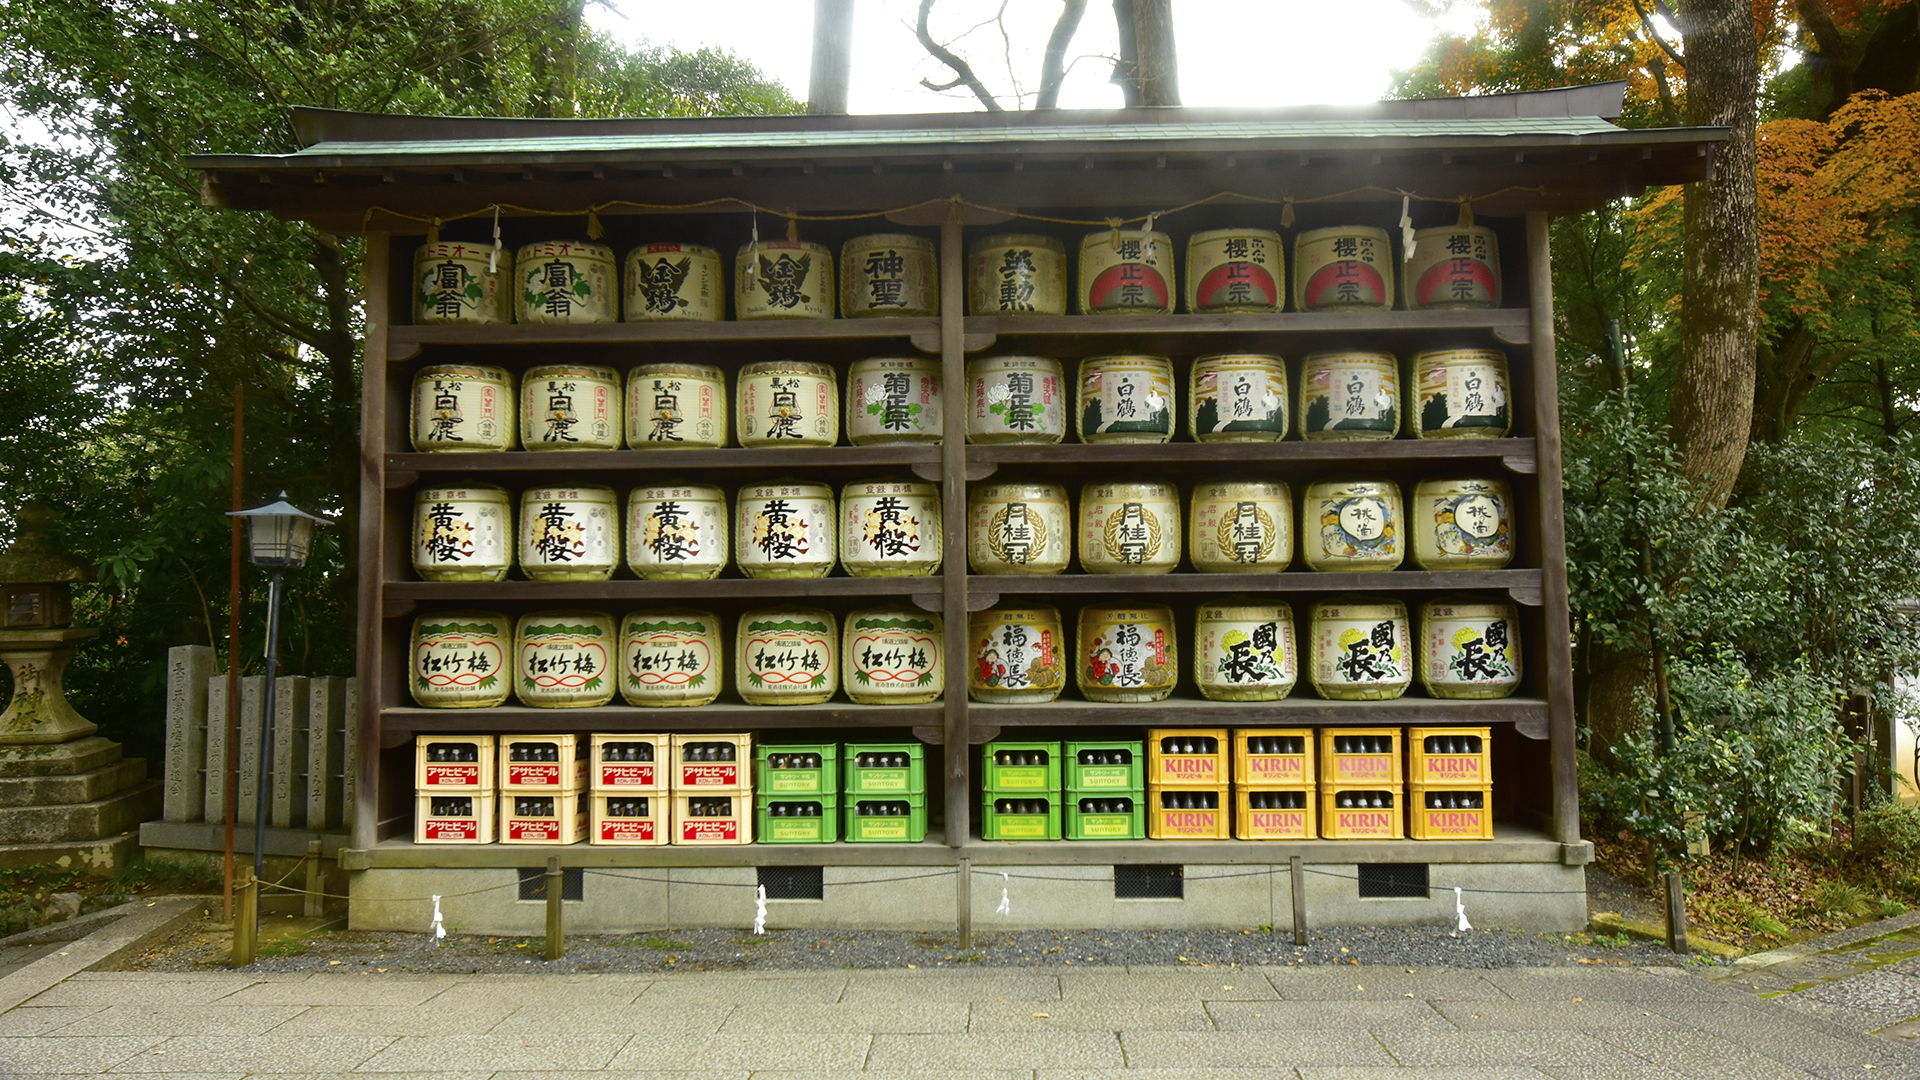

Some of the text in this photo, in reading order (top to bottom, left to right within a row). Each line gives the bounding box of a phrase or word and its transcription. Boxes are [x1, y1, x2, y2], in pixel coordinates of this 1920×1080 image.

[427, 244, 480, 258] トミオー
[533, 243, 586, 257] トミオー
[1117, 239, 1144, 306] 櫻正宗
[1223, 237, 1251, 304] 櫻正宗
[1332, 236, 1361, 302] 櫻正宗
[1446, 234, 1474, 300] 櫻正宗
[864, 249, 908, 310] 神聖
[884, 372, 911, 431] 菊正宗
[1007, 371, 1034, 431] 菊正宗
[1117, 377, 1136, 418] 白鶴
[1233, 375, 1253, 417] 白鶴
[1346, 374, 1365, 416] 白鶴
[1465, 371, 1484, 413] 白鶴
[428, 389, 464, 442] 白鹿
[543, 390, 579, 442] 白鹿
[648, 389, 684, 442] 白鹿
[766, 386, 803, 439] 白鹿
[1002, 502, 1031, 565] 月桂冠
[1118, 502, 1147, 565] 月桂冠
[1232, 501, 1262, 564] 月桂冠
[422, 650, 491, 674] 松竹梅
[528, 651, 597, 675] 松竹梅
[632, 649, 700, 673] 松竹梅
[754, 647, 822, 672] 松竹梅
[861, 645, 929, 670] 松竹梅
[427, 767, 478, 777] アサヒビール
[509, 767, 559, 777] アサヒビール
[603, 767, 654, 777] アサヒビール
[684, 767, 736, 777] アサヒビール
[1165, 759, 1214, 773] KIRIN
[1251, 758, 1300, 772] KIRIN
[1338, 757, 1388, 771] KIRIN
[1428, 758, 1478, 772] KIRIN
[426, 821, 477, 831] アサヒビール
[509, 821, 559, 832] アサヒビール
[602, 821, 653, 832] アサヒビール
[684, 821, 736, 832] アサヒビール
[1165, 813, 1214, 827] KIRIN
[1253, 813, 1302, 827] KIRIN
[1339, 813, 1389, 827] KIRIN
[1429, 813, 1479, 827] KIRIN
